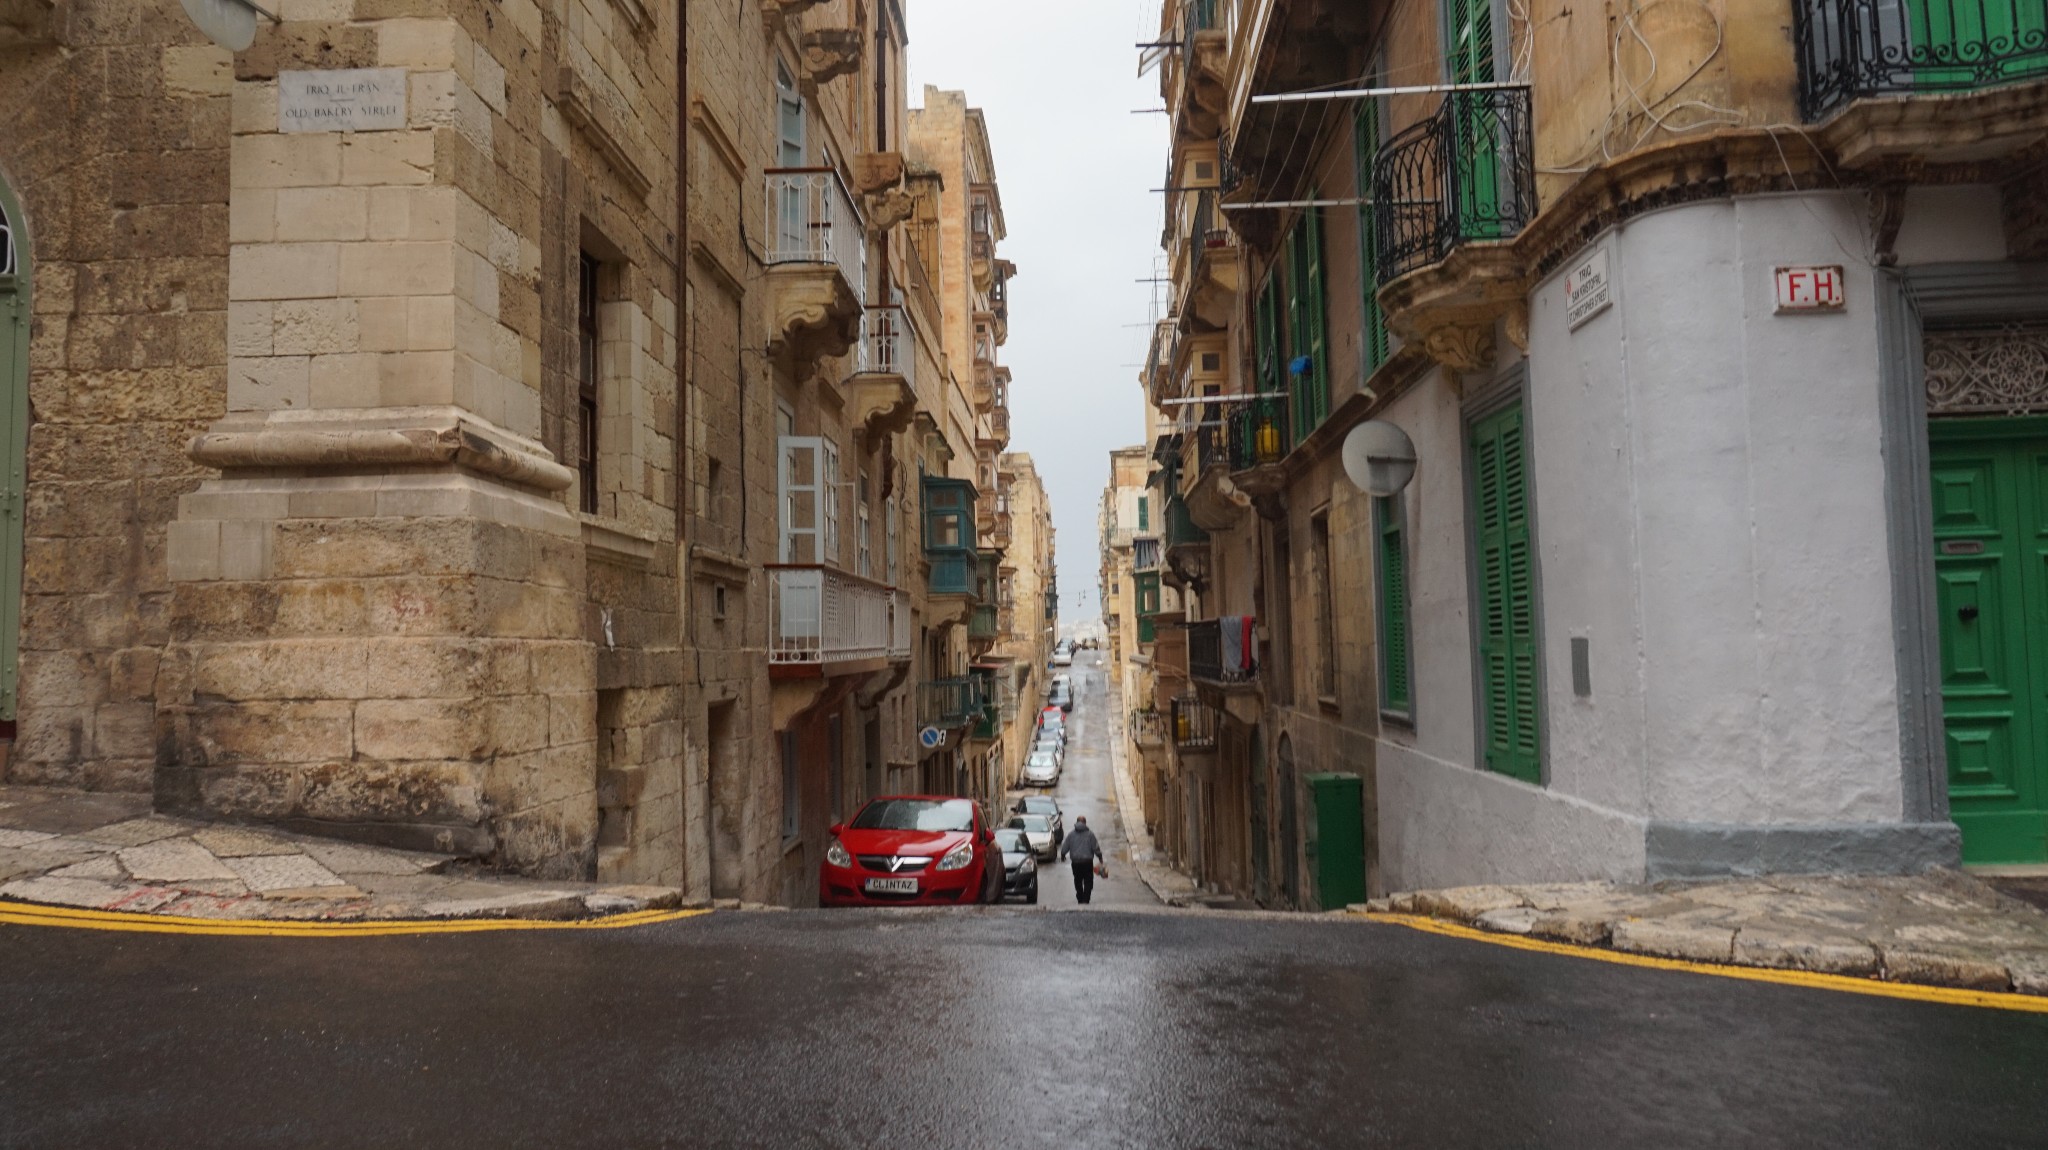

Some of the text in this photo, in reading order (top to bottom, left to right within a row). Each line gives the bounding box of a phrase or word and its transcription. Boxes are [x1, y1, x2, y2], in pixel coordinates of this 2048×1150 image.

[306, 84, 330, 96] TRIQ
[285, 105, 397, 119] OLD BAKERY STREET
[1579, 264, 1591, 281] TRIQ
[1789, 272, 1840, 302] F.H.
[1571, 289, 1580, 303] SAN
[1595, 287, 1607, 306] STREET
